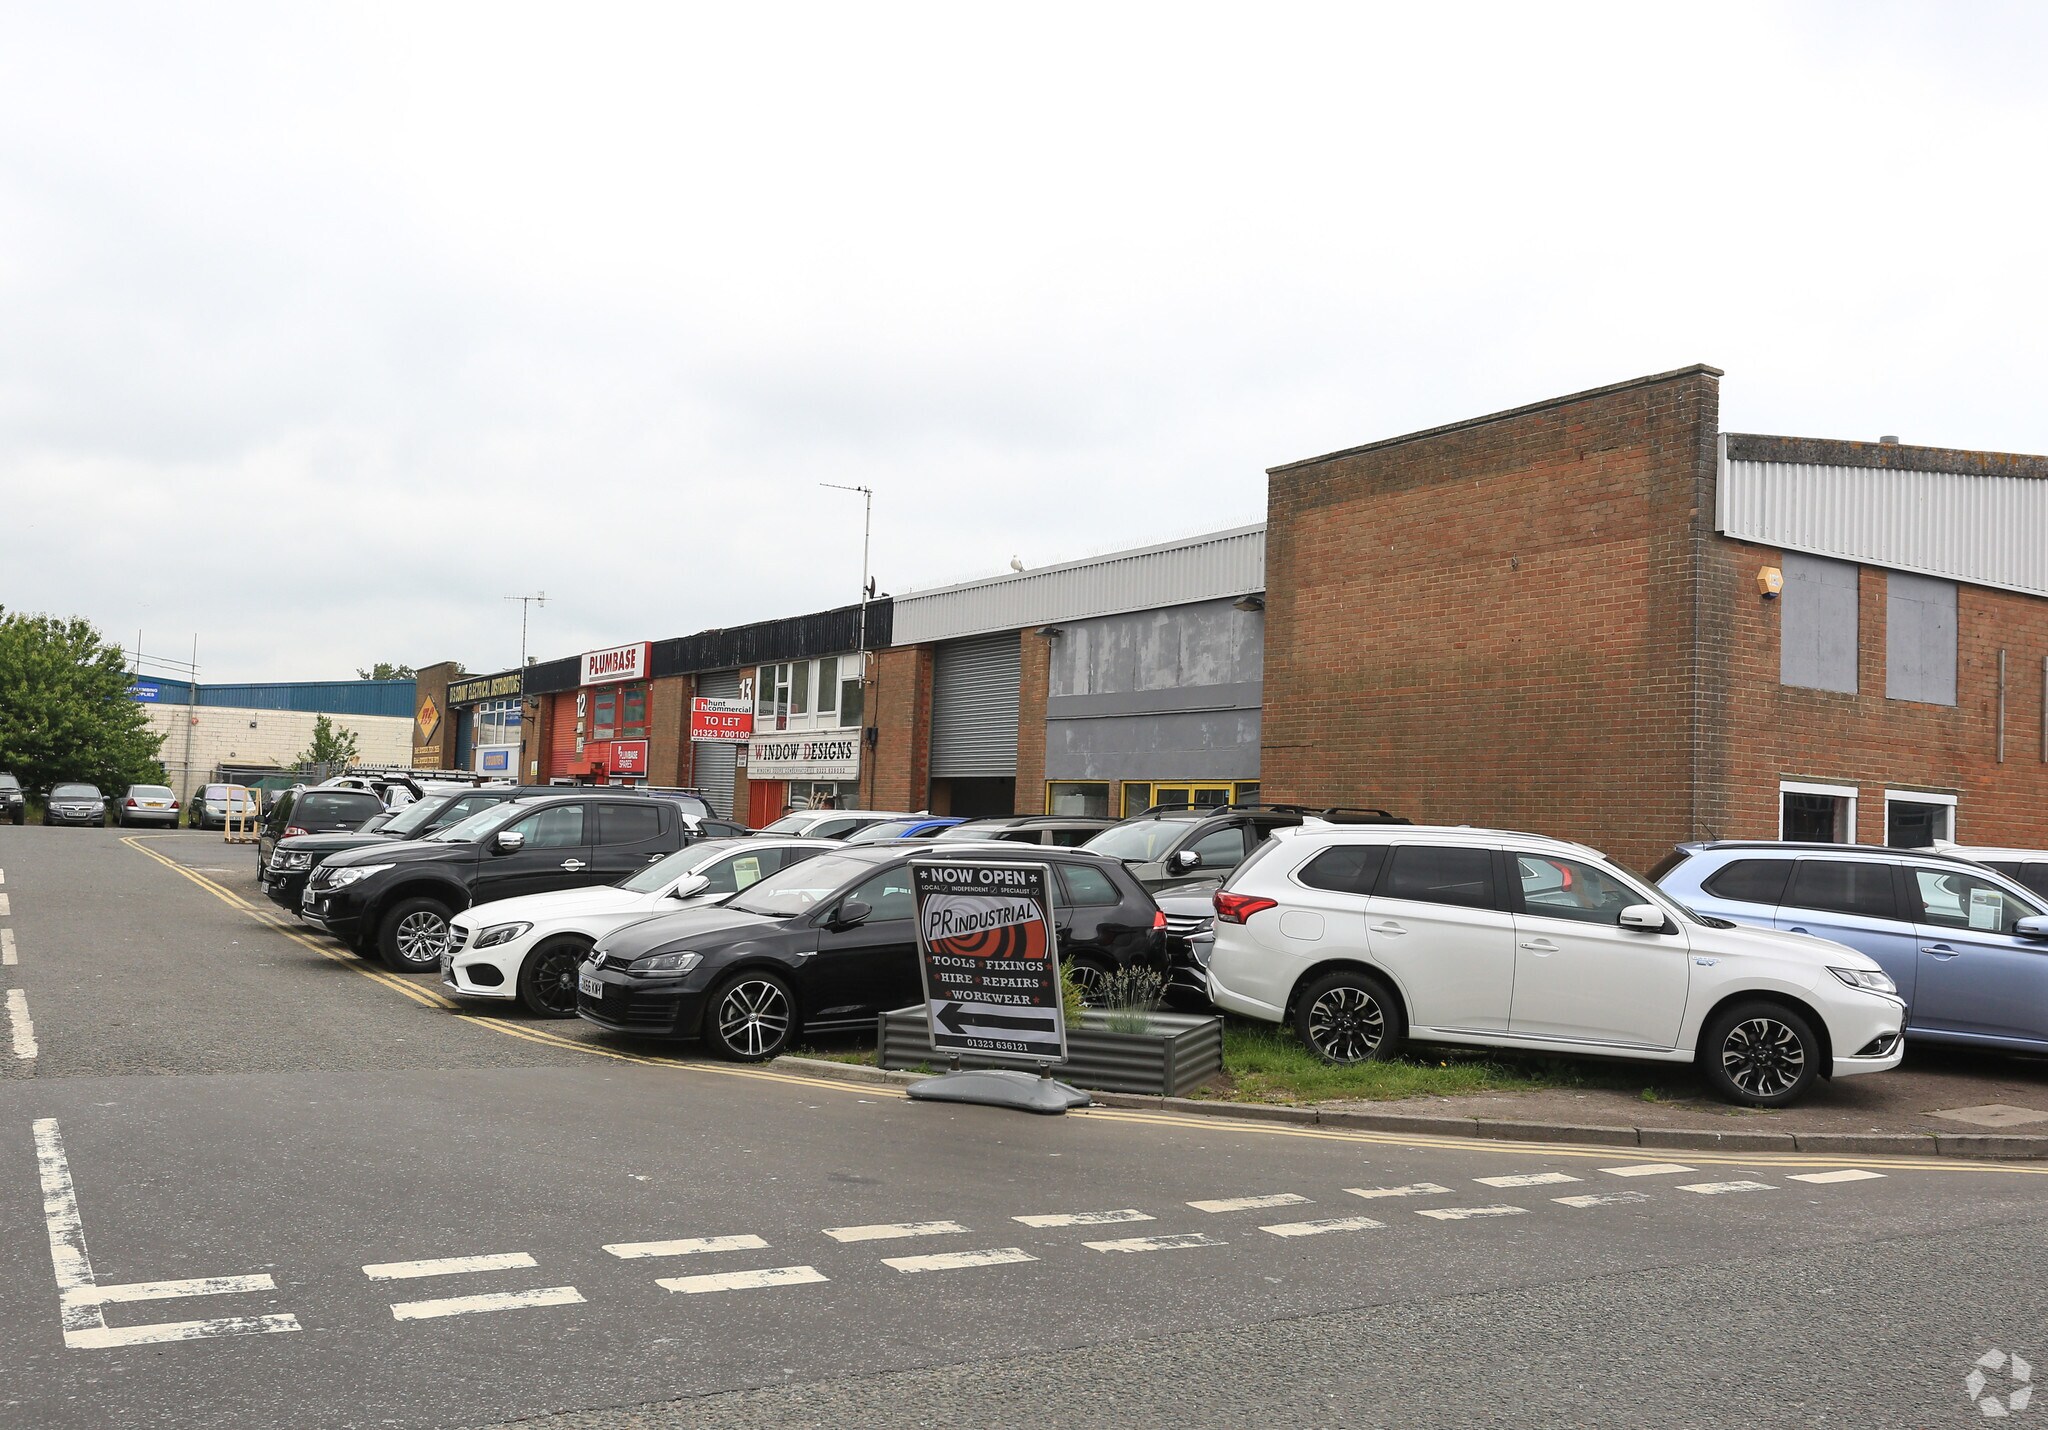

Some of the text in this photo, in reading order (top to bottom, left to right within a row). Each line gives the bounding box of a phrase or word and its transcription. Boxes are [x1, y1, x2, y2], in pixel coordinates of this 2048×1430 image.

[589, 648, 637, 675] PLUMBASE
[740, 677, 753, 700] 13
[576, 693, 587, 718] 12
[708, 705, 752, 713] commercial
[704, 716, 741, 727] TO LET
[693, 728, 750, 739] 01323 700100
[755, 743, 800, 761] WINDOW
[803, 741, 852, 760] DESIGNS
[931, 868, 1026, 885] NOW OPEN
[932, 956, 1044, 972] TOOLS FIXINGS
[940, 973, 1039, 988] HIRE REPAIRS
[951, 989, 1032, 1005] WORKWEAR
[966, 1038, 1028, 1051] 01323 636121
